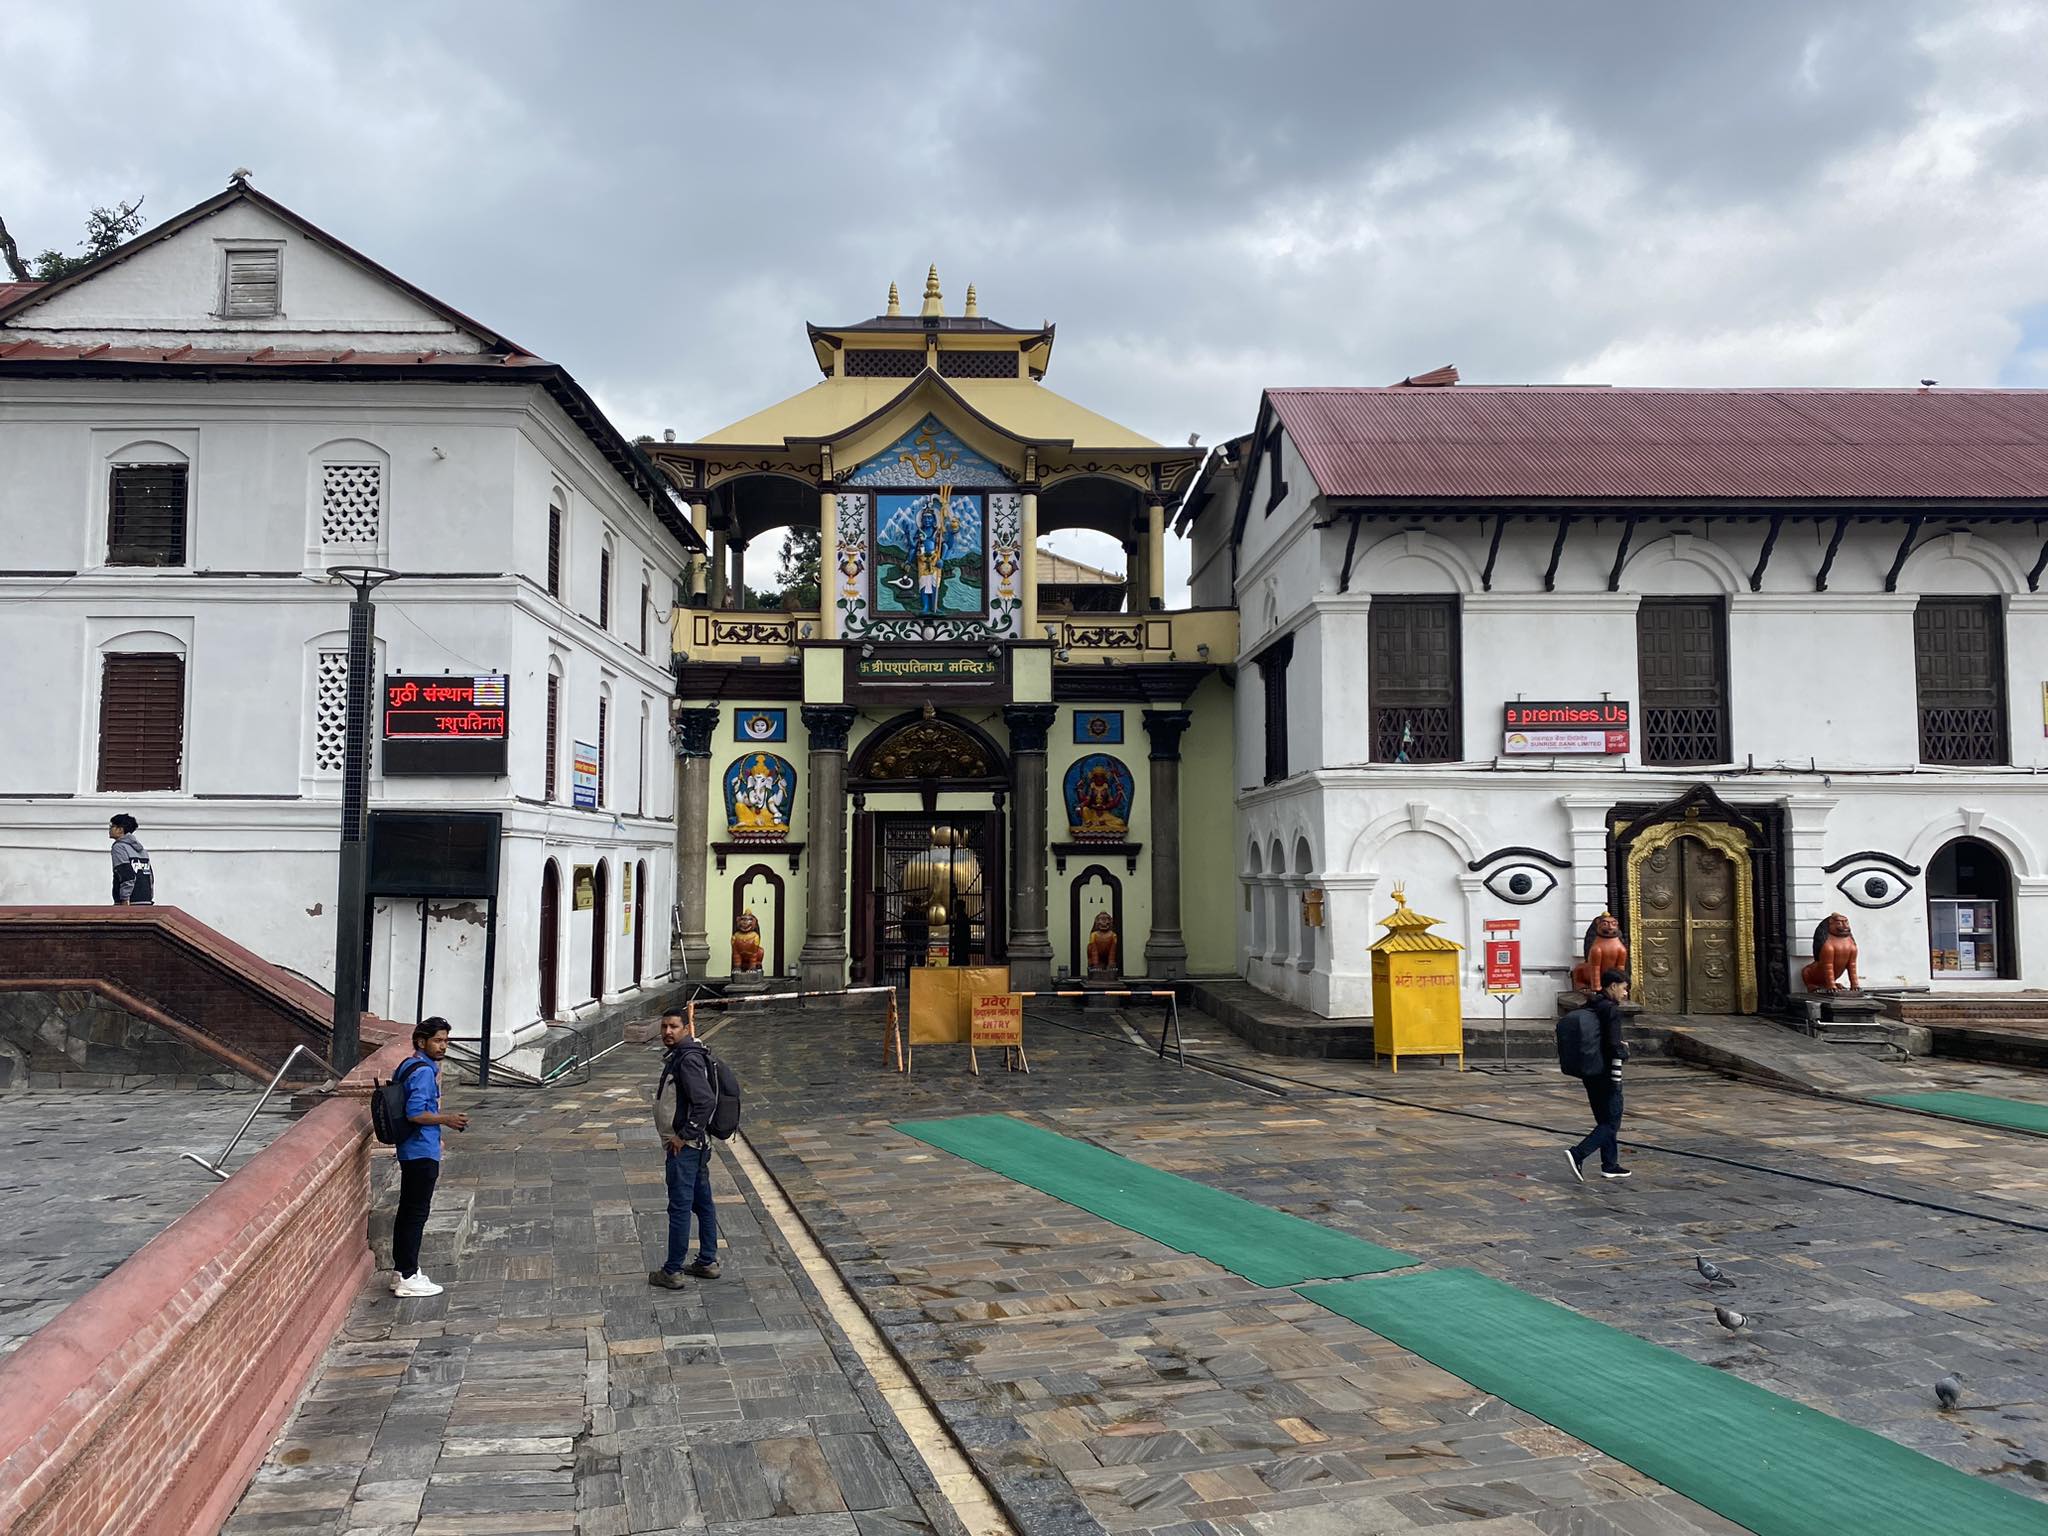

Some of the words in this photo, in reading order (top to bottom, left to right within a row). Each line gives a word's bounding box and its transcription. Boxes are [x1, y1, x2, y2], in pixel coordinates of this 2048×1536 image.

[948, 659, 984, 674] मन्दिर
[389, 682, 419, 707] गुठी
[423, 683, 474, 702] संस्थान
[980, 995, 1012, 1009] प्रवेश
[982, 1020, 1010, 1029] ENTRY
